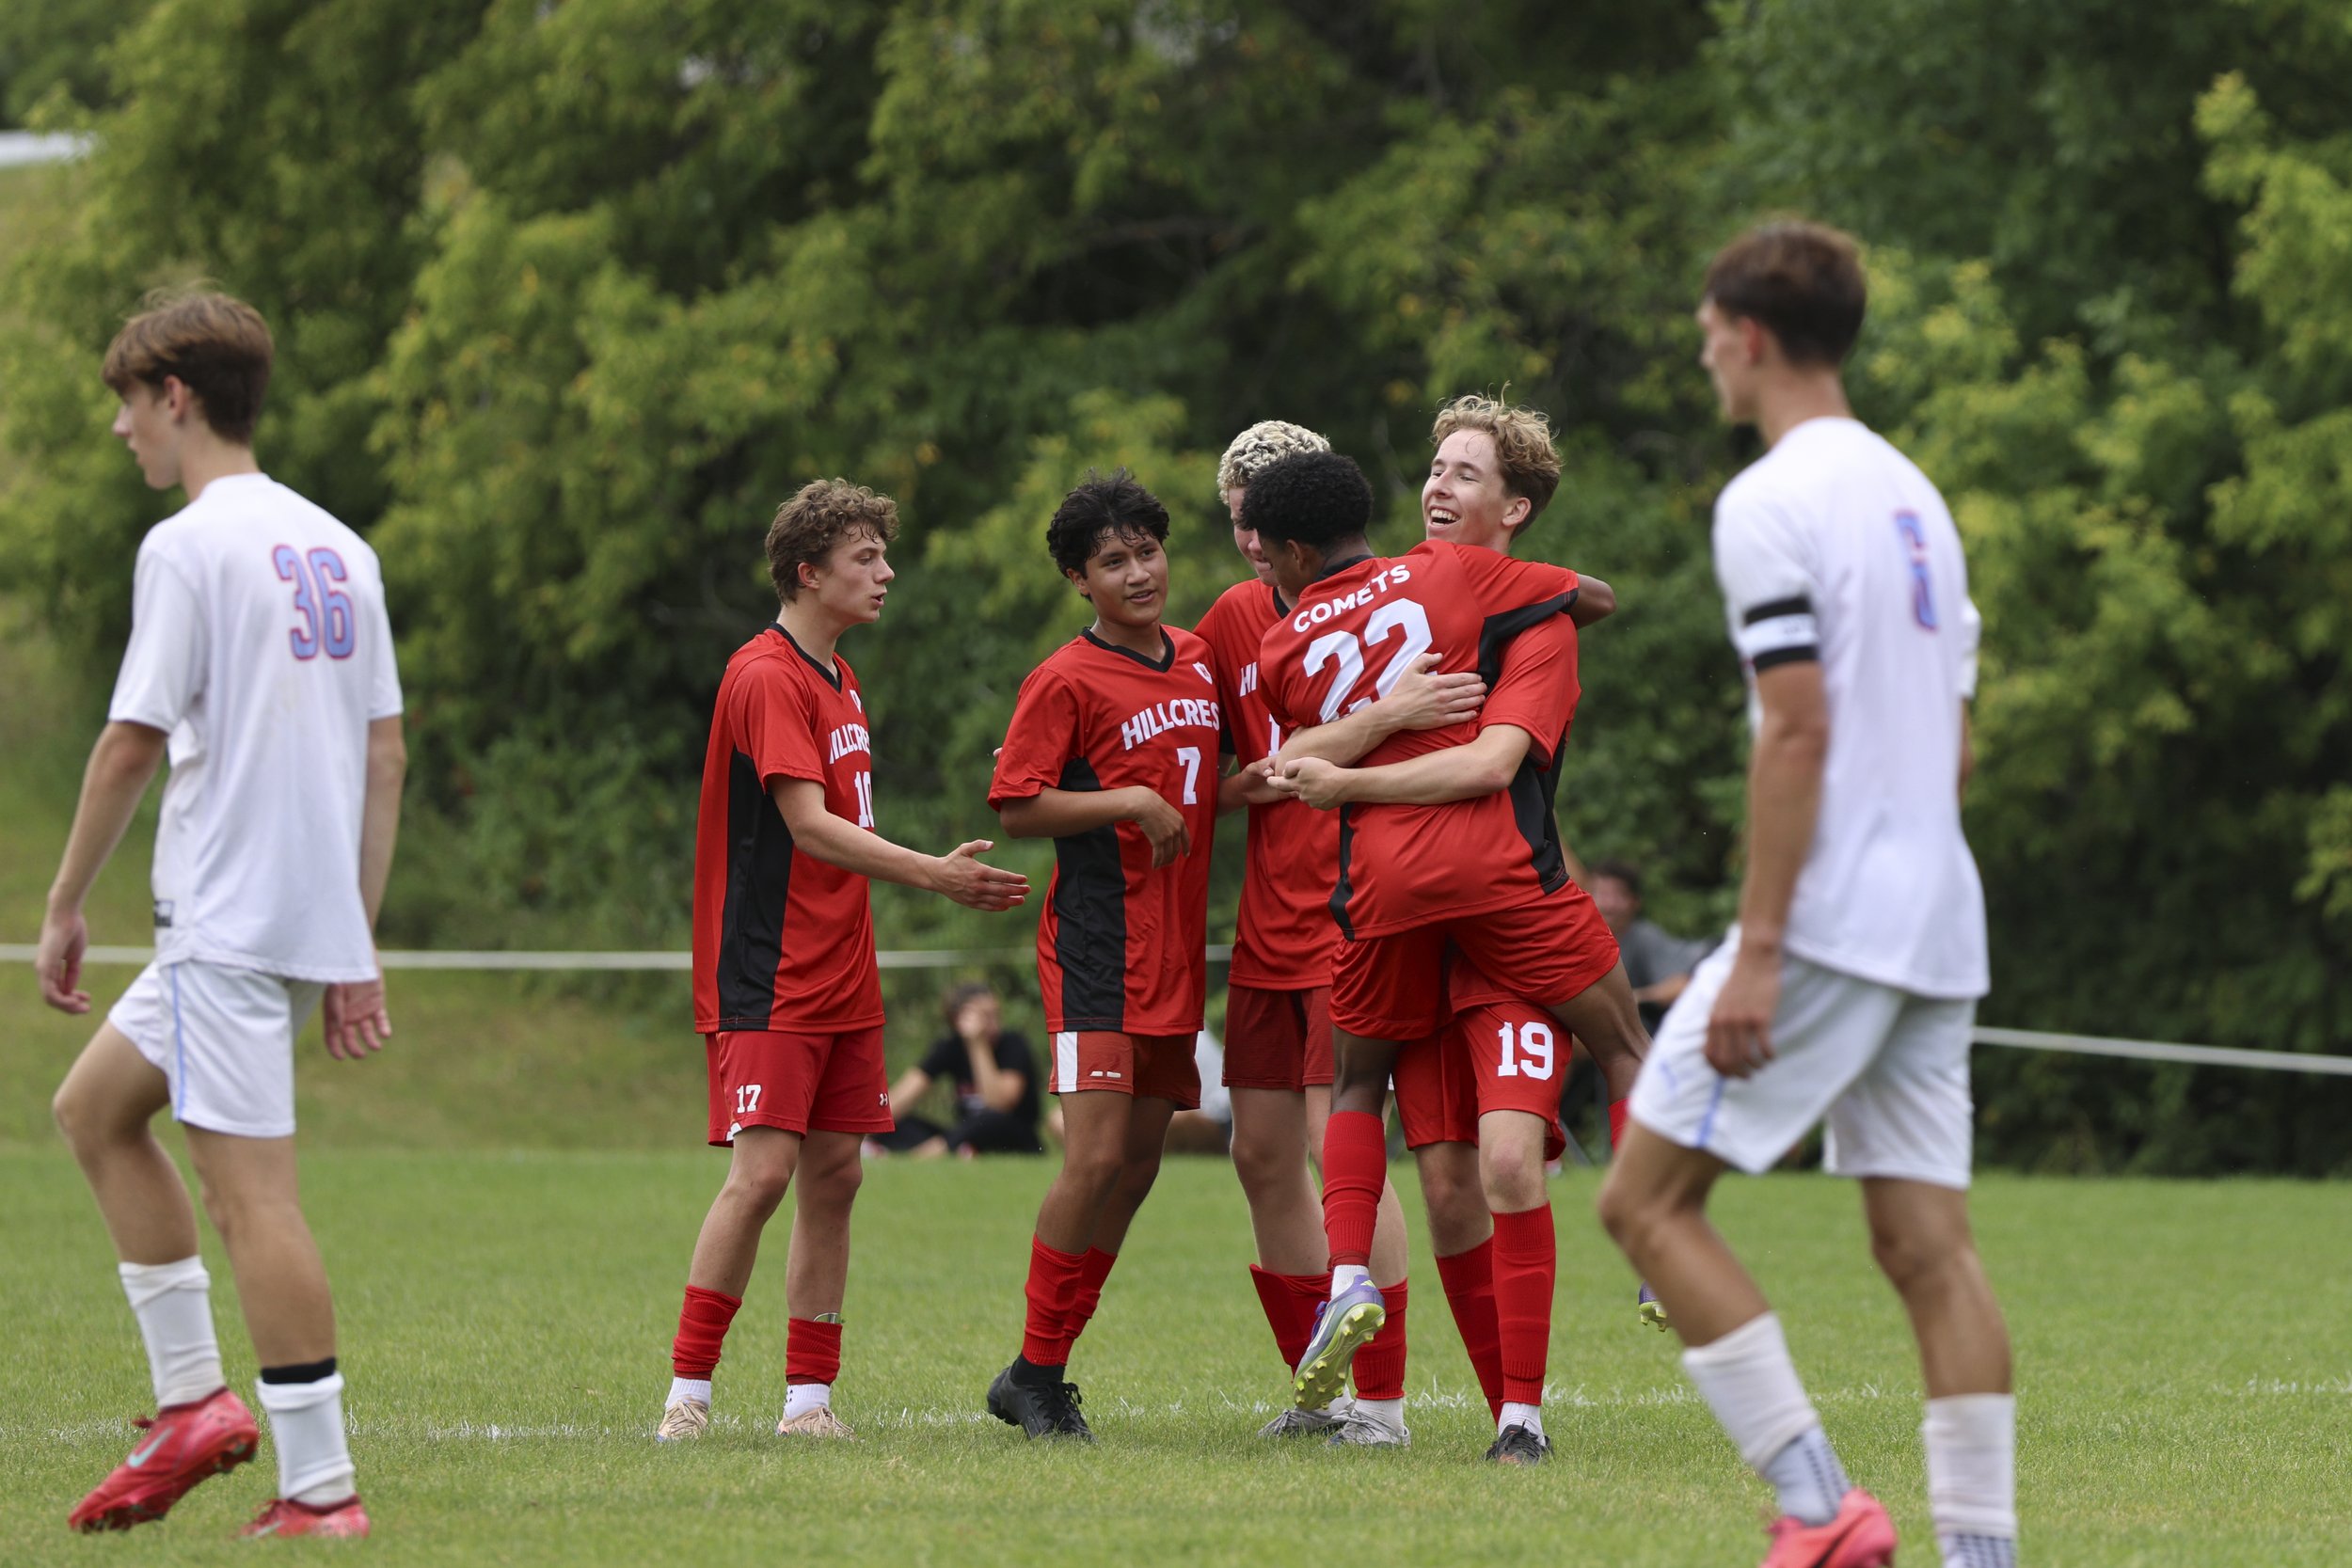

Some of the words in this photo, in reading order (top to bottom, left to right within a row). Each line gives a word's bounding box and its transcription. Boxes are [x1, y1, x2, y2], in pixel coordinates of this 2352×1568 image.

[272, 544, 355, 660] 36
[1294, 564, 1410, 633] COMETS
[1303, 597, 1438, 724] 22
[1121, 699, 1220, 751] HILLCRES
[1177, 746, 1201, 805] 7
[1497, 1021, 1553, 1081] 19
[737, 1085, 762, 1114] 17
